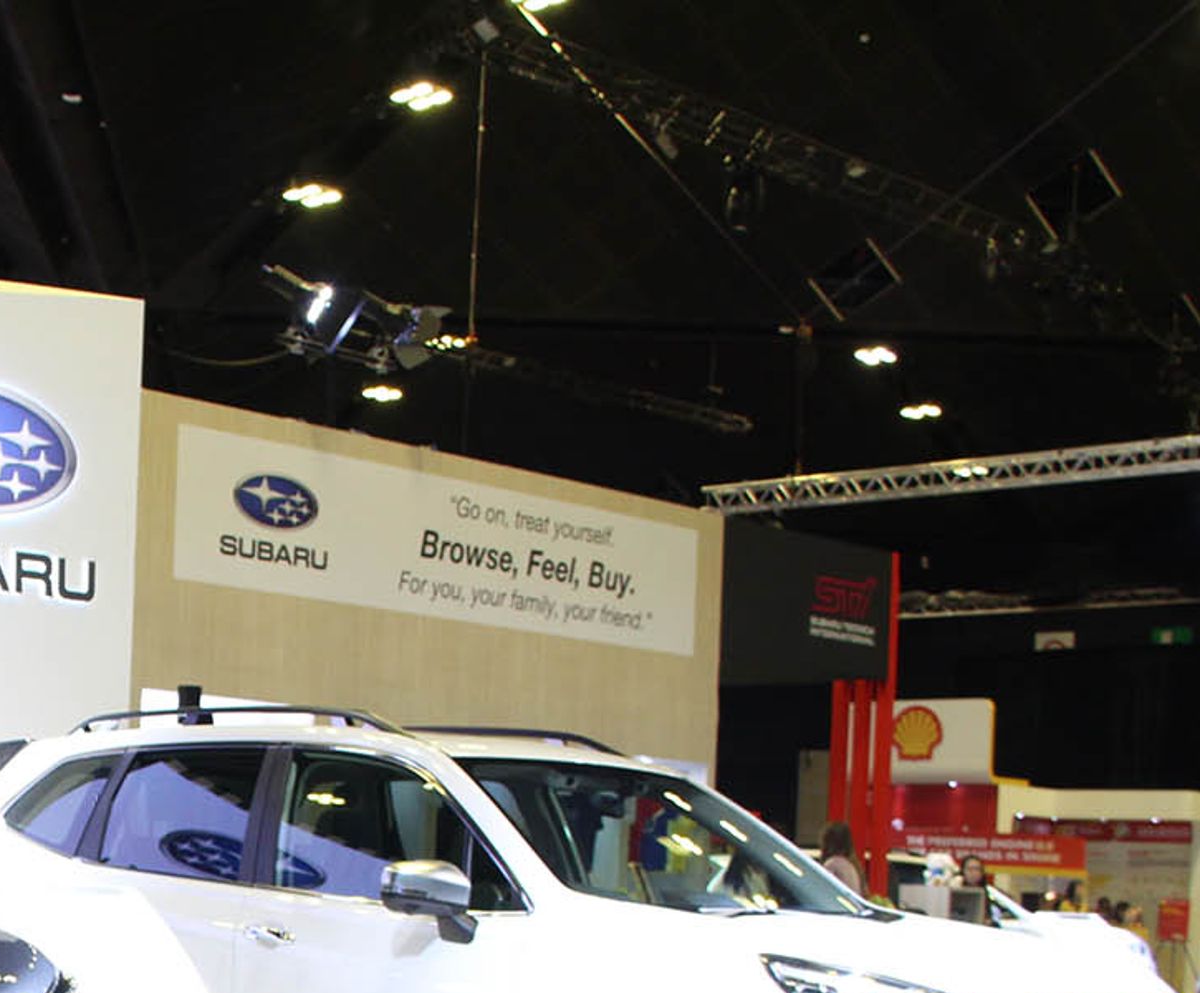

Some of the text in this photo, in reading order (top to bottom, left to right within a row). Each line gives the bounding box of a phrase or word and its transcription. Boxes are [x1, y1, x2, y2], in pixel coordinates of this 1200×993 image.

[515, 511, 550, 534] treat
[219, 533, 329, 571] SUBARU
[419, 528, 636, 599] Browse, Feel, Buy.
[398, 570, 426, 595] For
[430, 580, 465, 602] you,
[469, 586, 507, 608] your
[509, 589, 559, 619] family,
[562, 602, 597, 623] your
